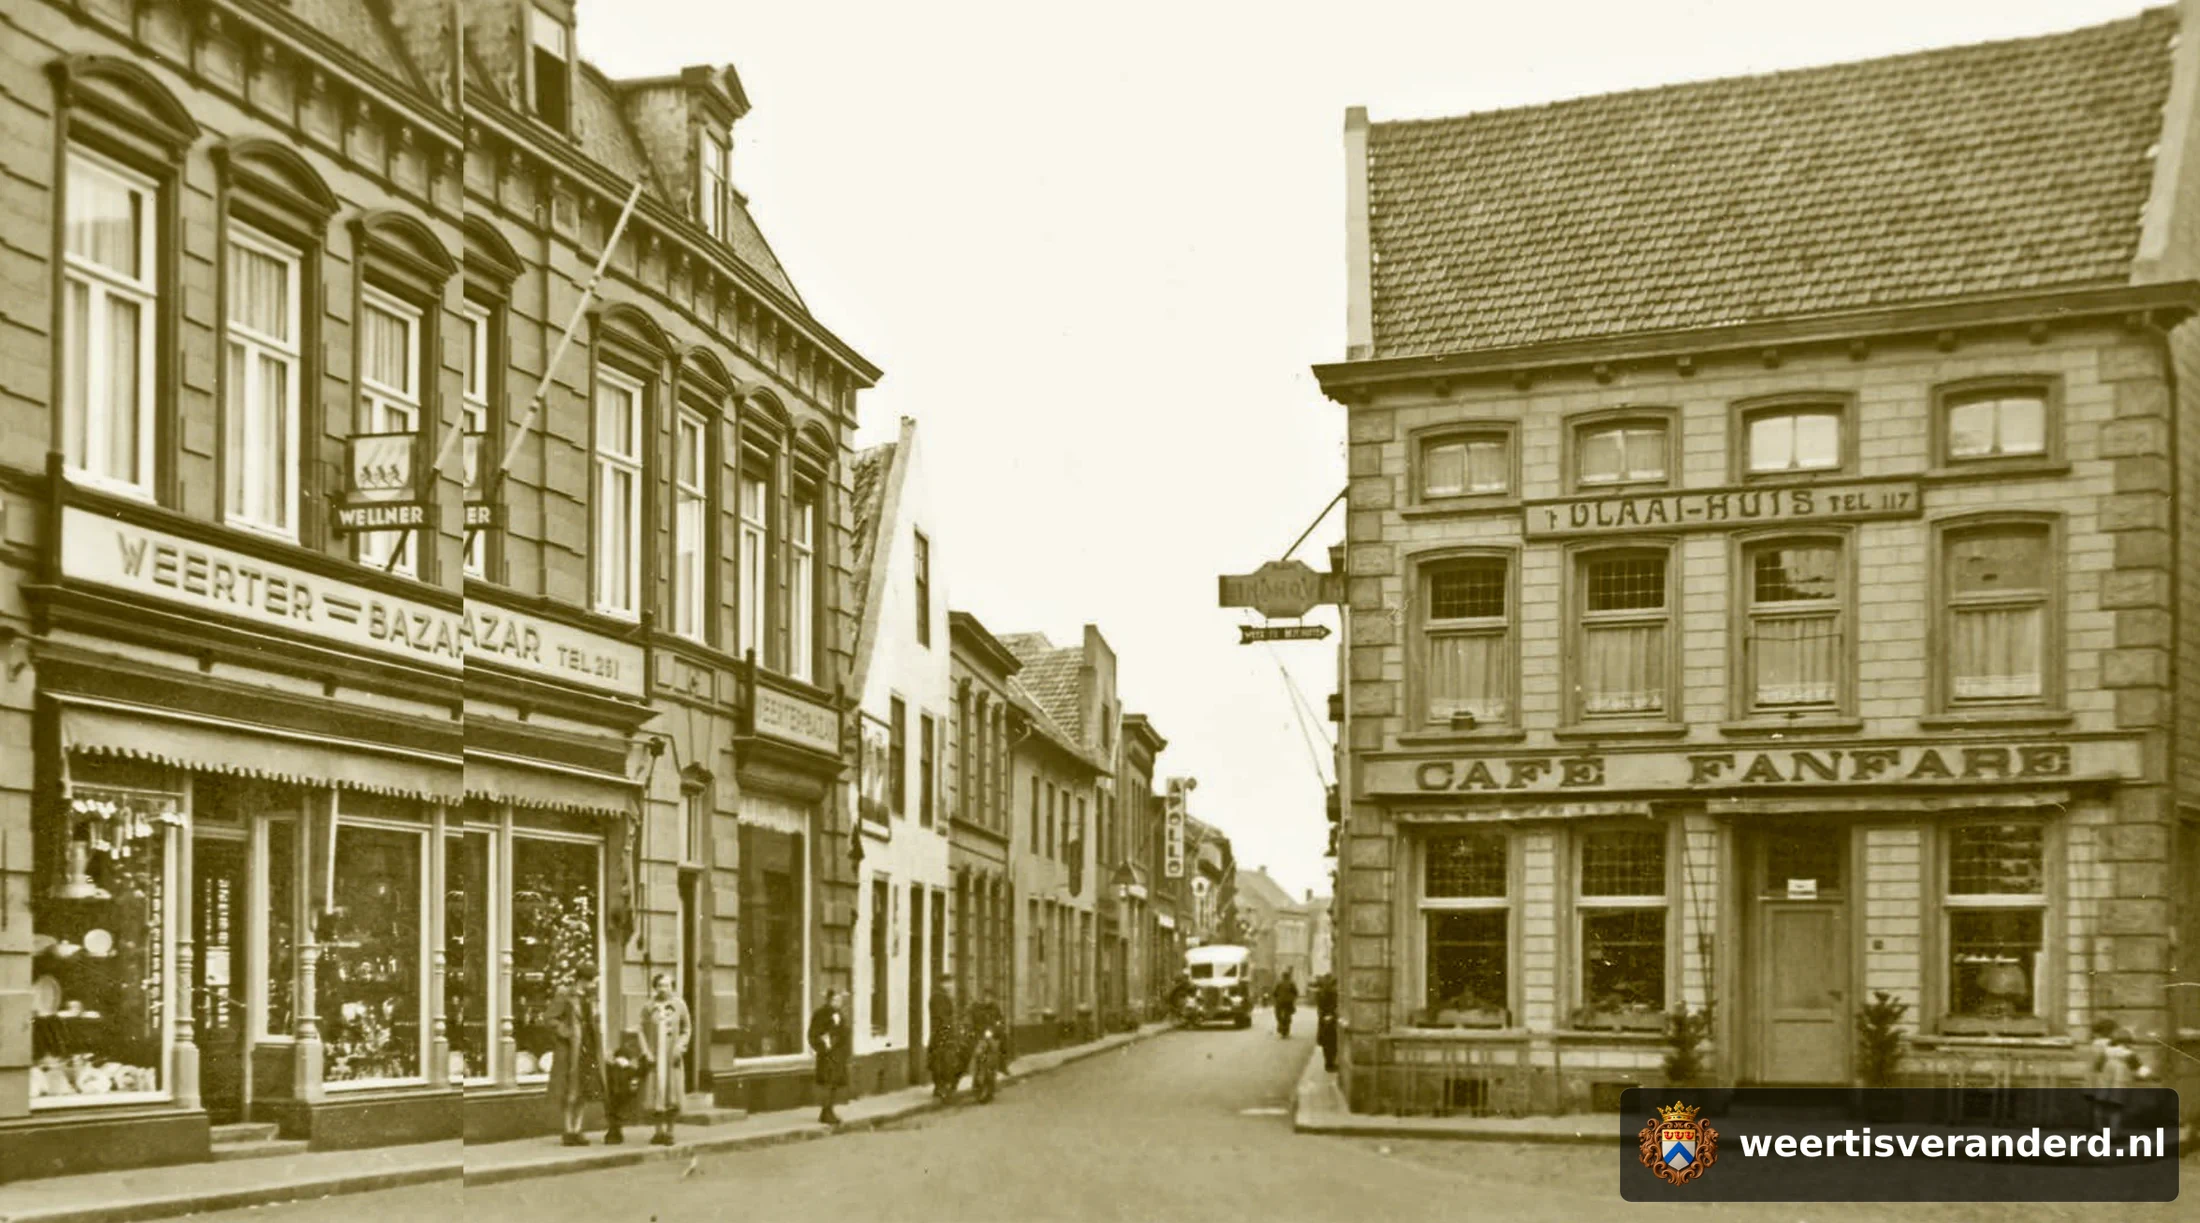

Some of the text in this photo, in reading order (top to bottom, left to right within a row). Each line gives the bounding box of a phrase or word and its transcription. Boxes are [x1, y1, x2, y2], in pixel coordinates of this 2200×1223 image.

[339, 505, 424, 526] WELLNER
[1882, 492, 1911, 510] 117
[1687, 745, 2072, 786] FANFARE
[1167, 779, 1182, 875] APOLLO
